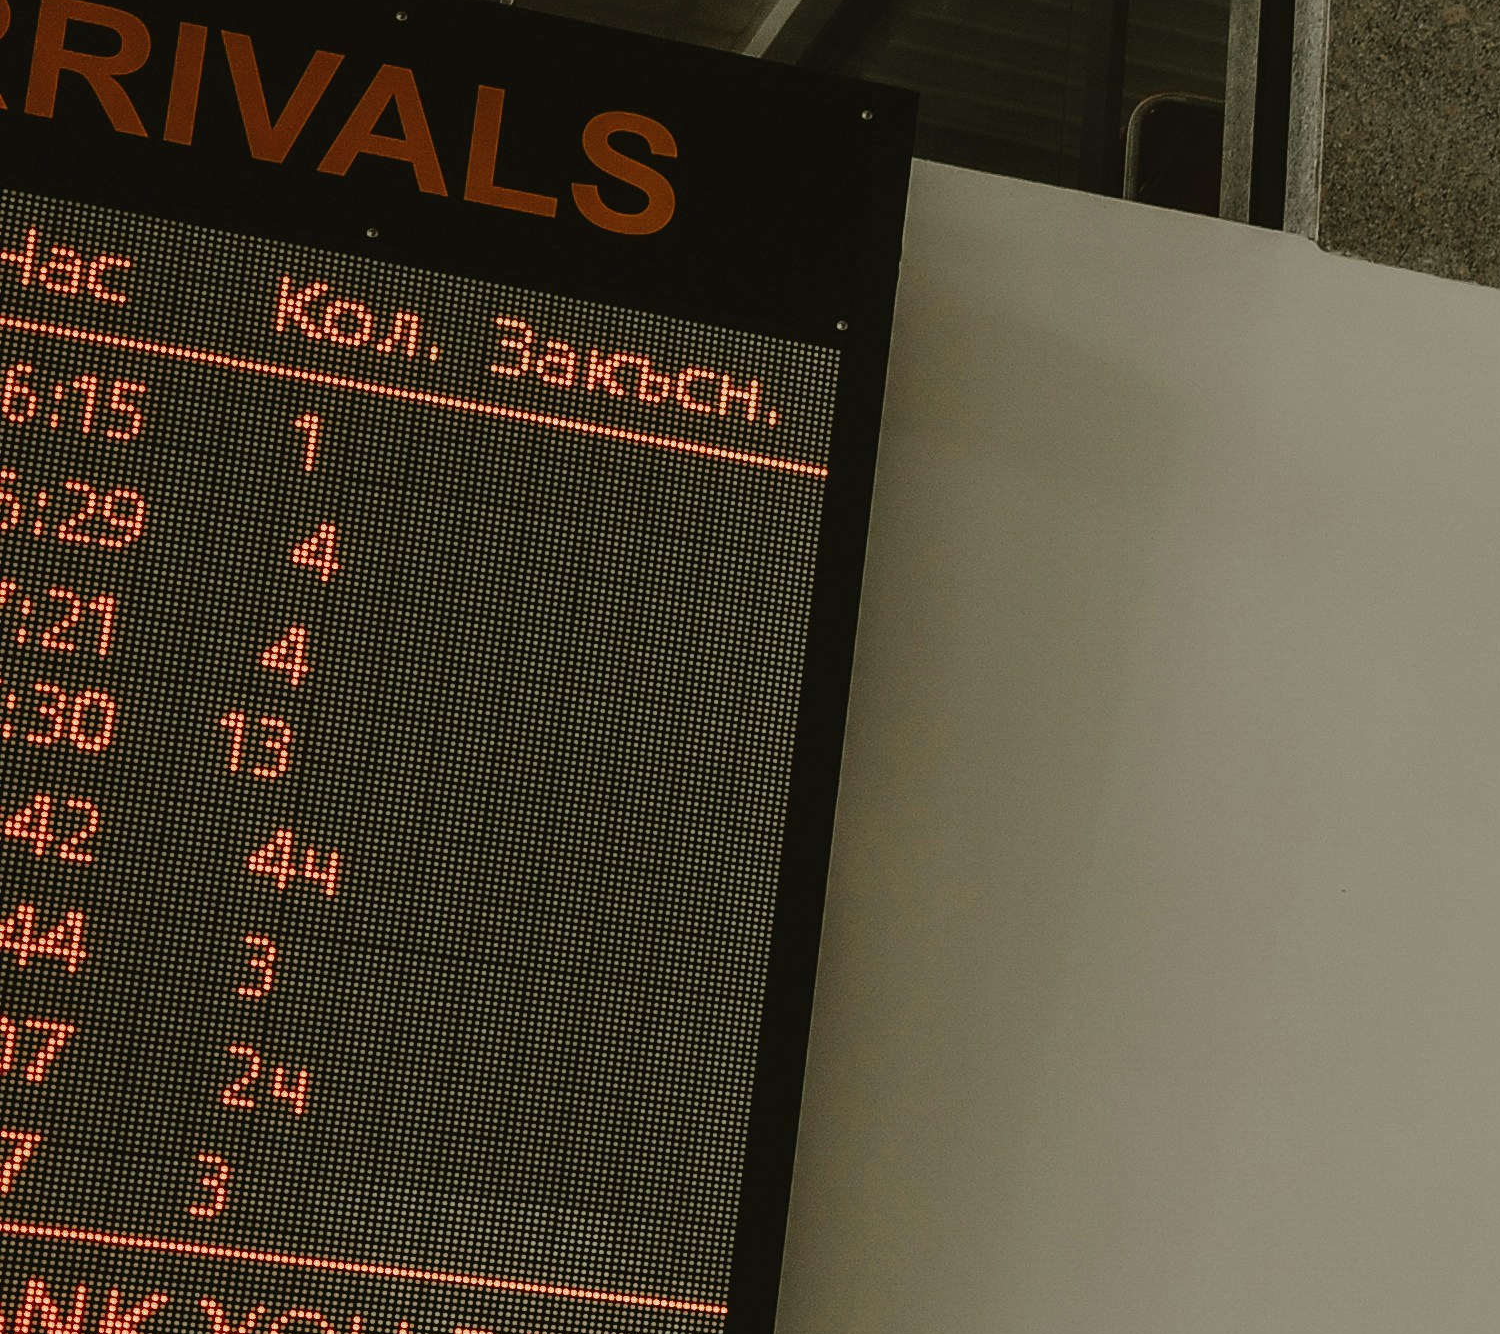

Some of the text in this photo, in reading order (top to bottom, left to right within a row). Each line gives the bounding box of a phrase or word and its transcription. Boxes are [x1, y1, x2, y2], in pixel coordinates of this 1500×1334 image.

[275, 275, 439, 362] Кол.
[490, 317, 781, 426] Закъсн.
[294, 411, 324, 472] 1
[292, 523, 341, 582] 4
[256, 622, 314, 686] 4
[219, 711, 293, 780] 13
[237, 935, 277, 1001] 3
[189, 1150, 234, 1221] 3
